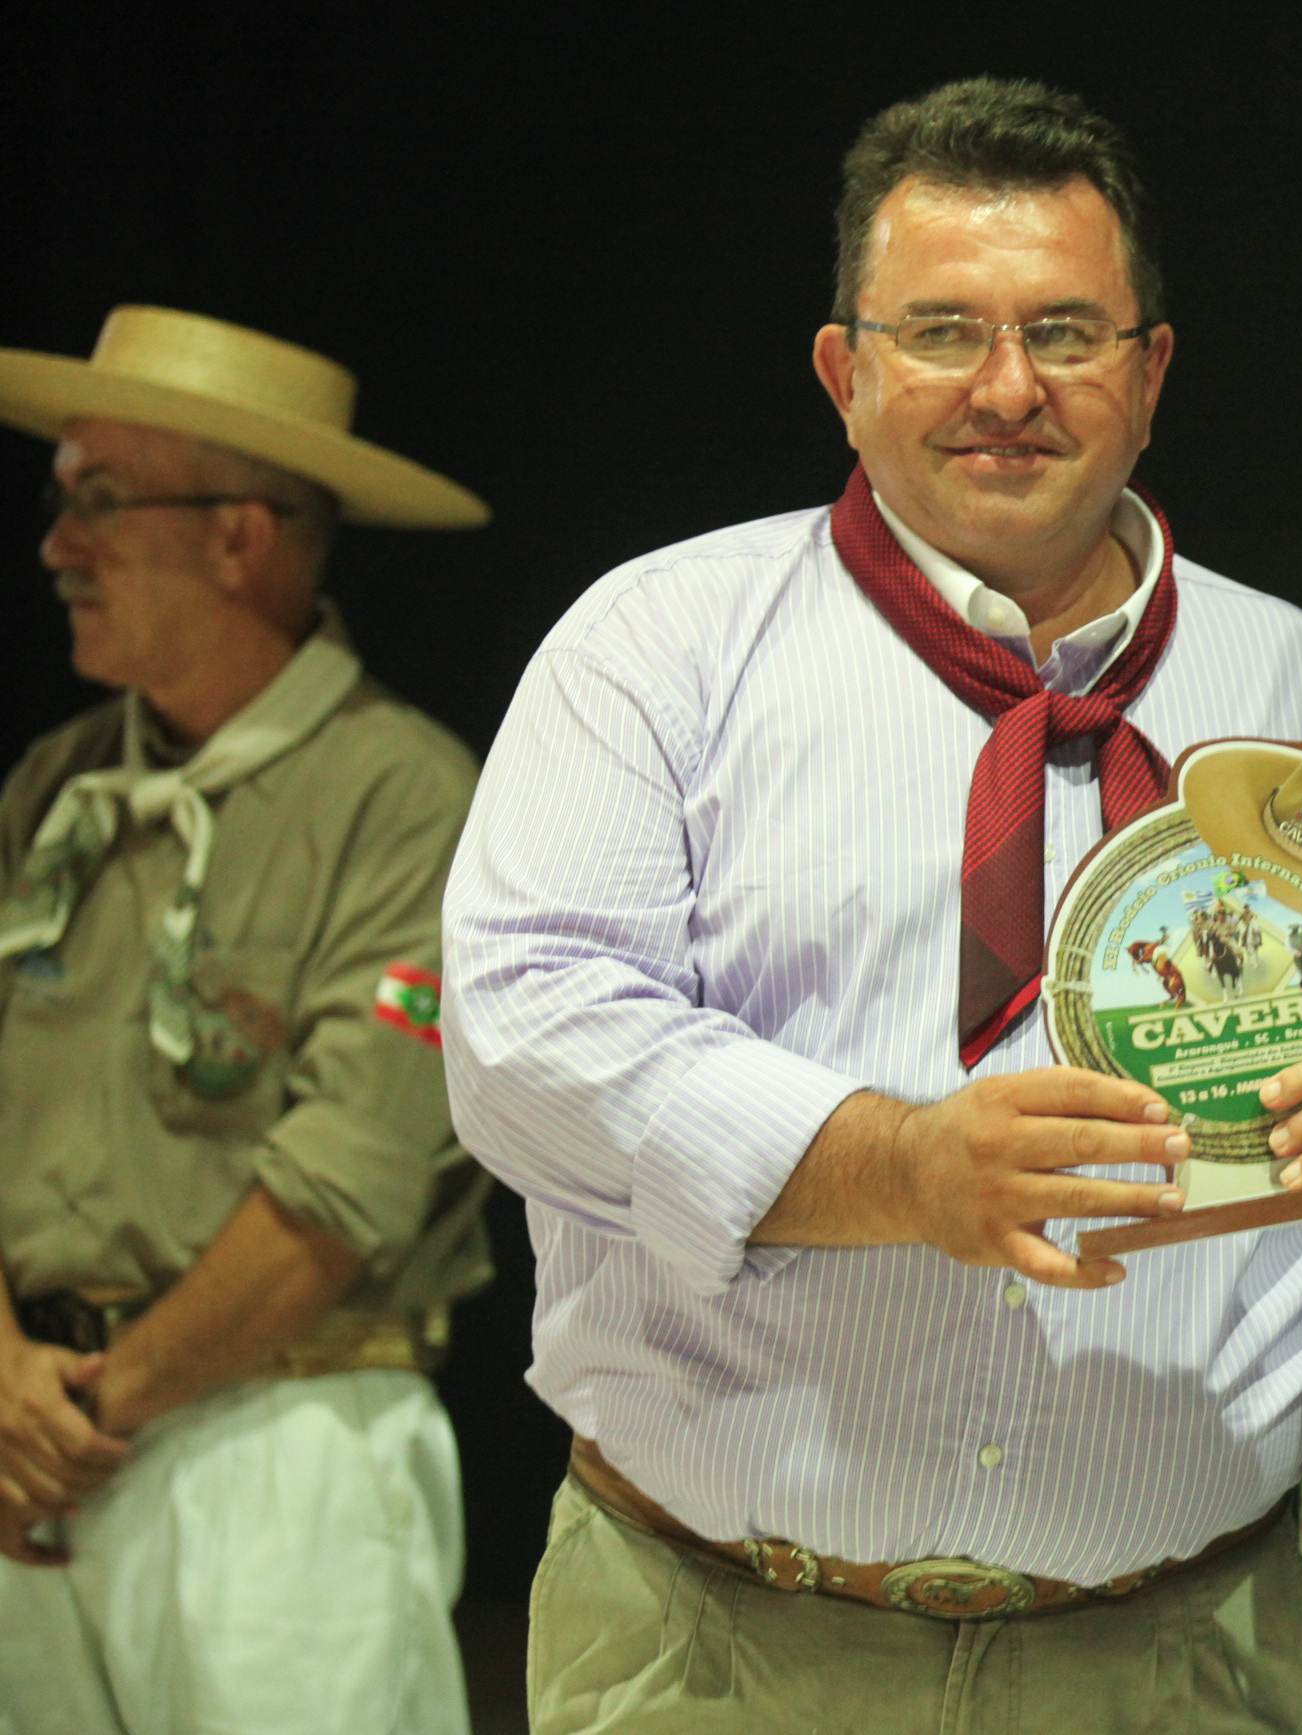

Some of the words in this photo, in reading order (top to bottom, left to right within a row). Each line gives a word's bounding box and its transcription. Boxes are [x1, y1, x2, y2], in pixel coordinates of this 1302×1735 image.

[1107, 885, 1158, 945] Rodeio
[1156, 854, 1227, 887] Crioulo
[1254, 1031, 1270, 1046] SC
[1179, 1089, 1197, 1106] 13
[1198, 1090, 1209, 1103] a
[1211, 1083, 1228, 1100] 16
